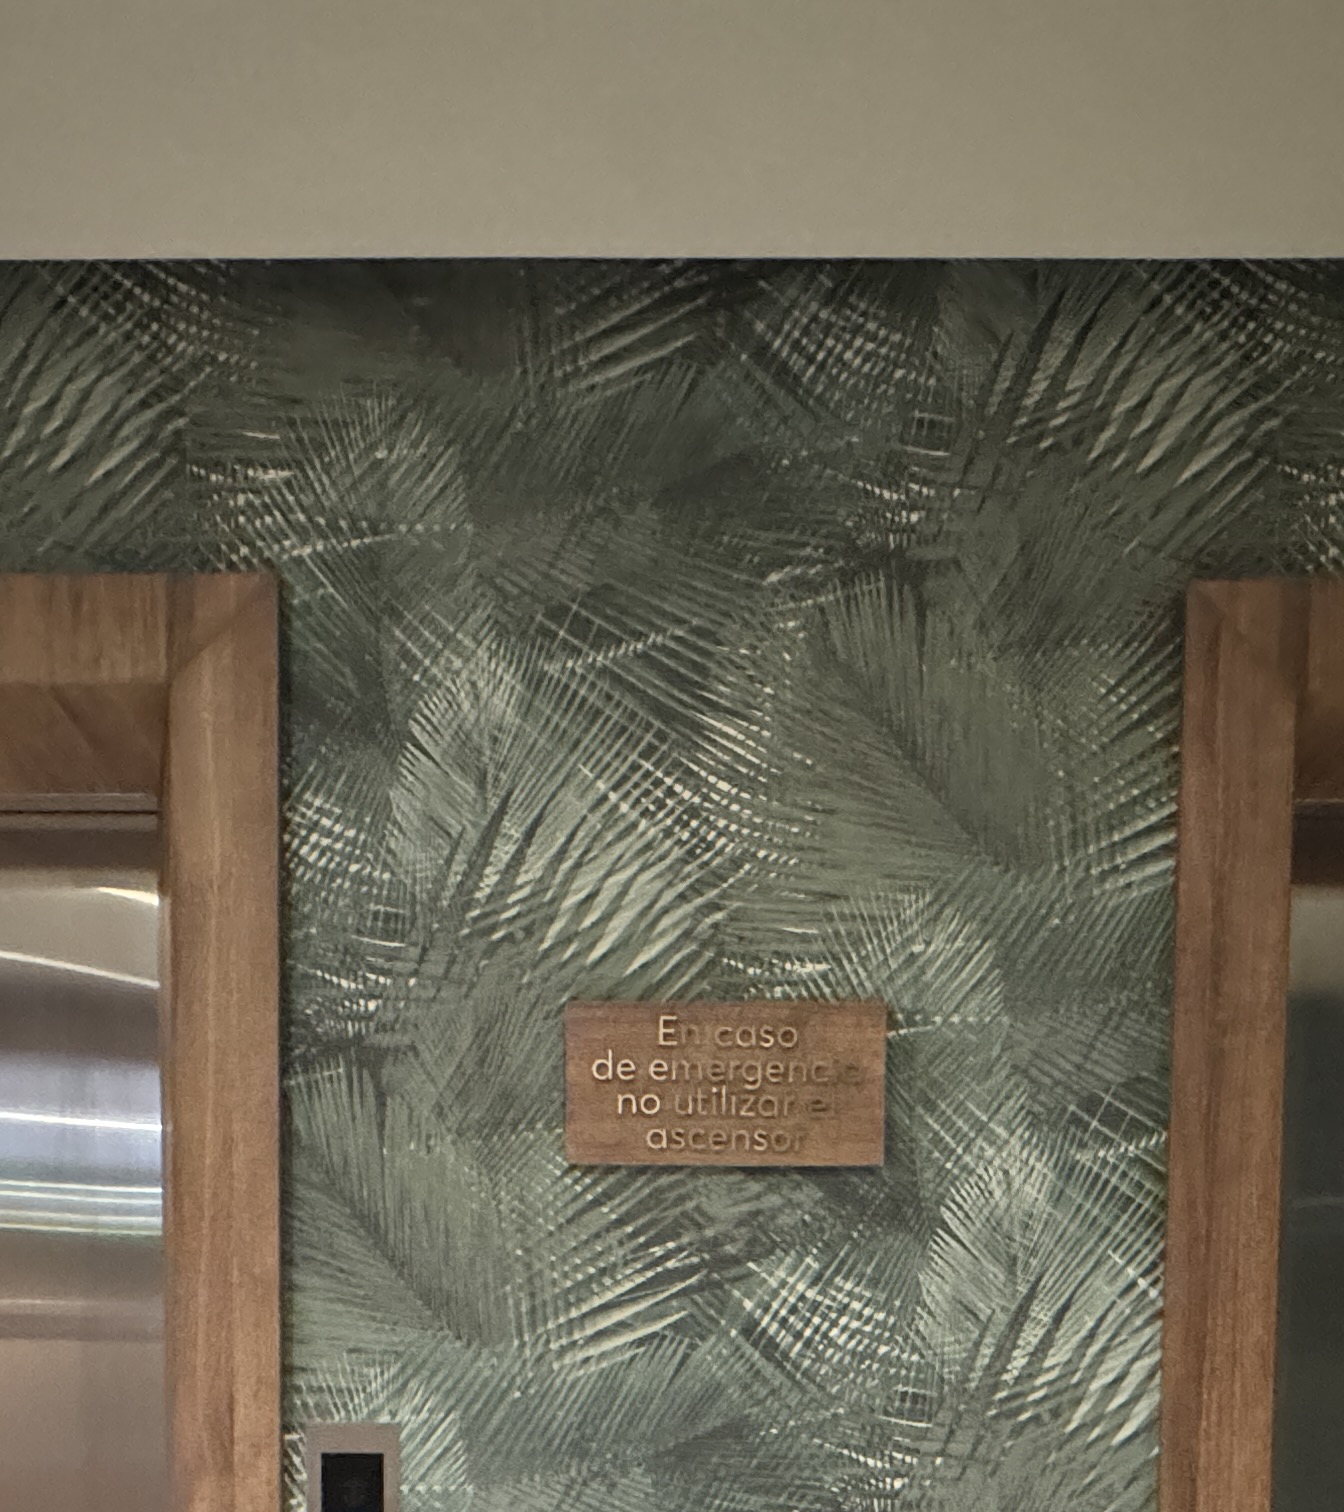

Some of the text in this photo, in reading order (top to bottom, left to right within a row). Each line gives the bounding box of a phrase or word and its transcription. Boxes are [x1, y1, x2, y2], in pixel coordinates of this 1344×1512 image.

[658, 1014, 799, 1049] En caso
[592, 1049, 864, 1090] de emergenca
[617, 1091, 661, 1115] no
[674, 1086, 795, 1118] utilizar
[645, 1125, 804, 1152] ascensor
